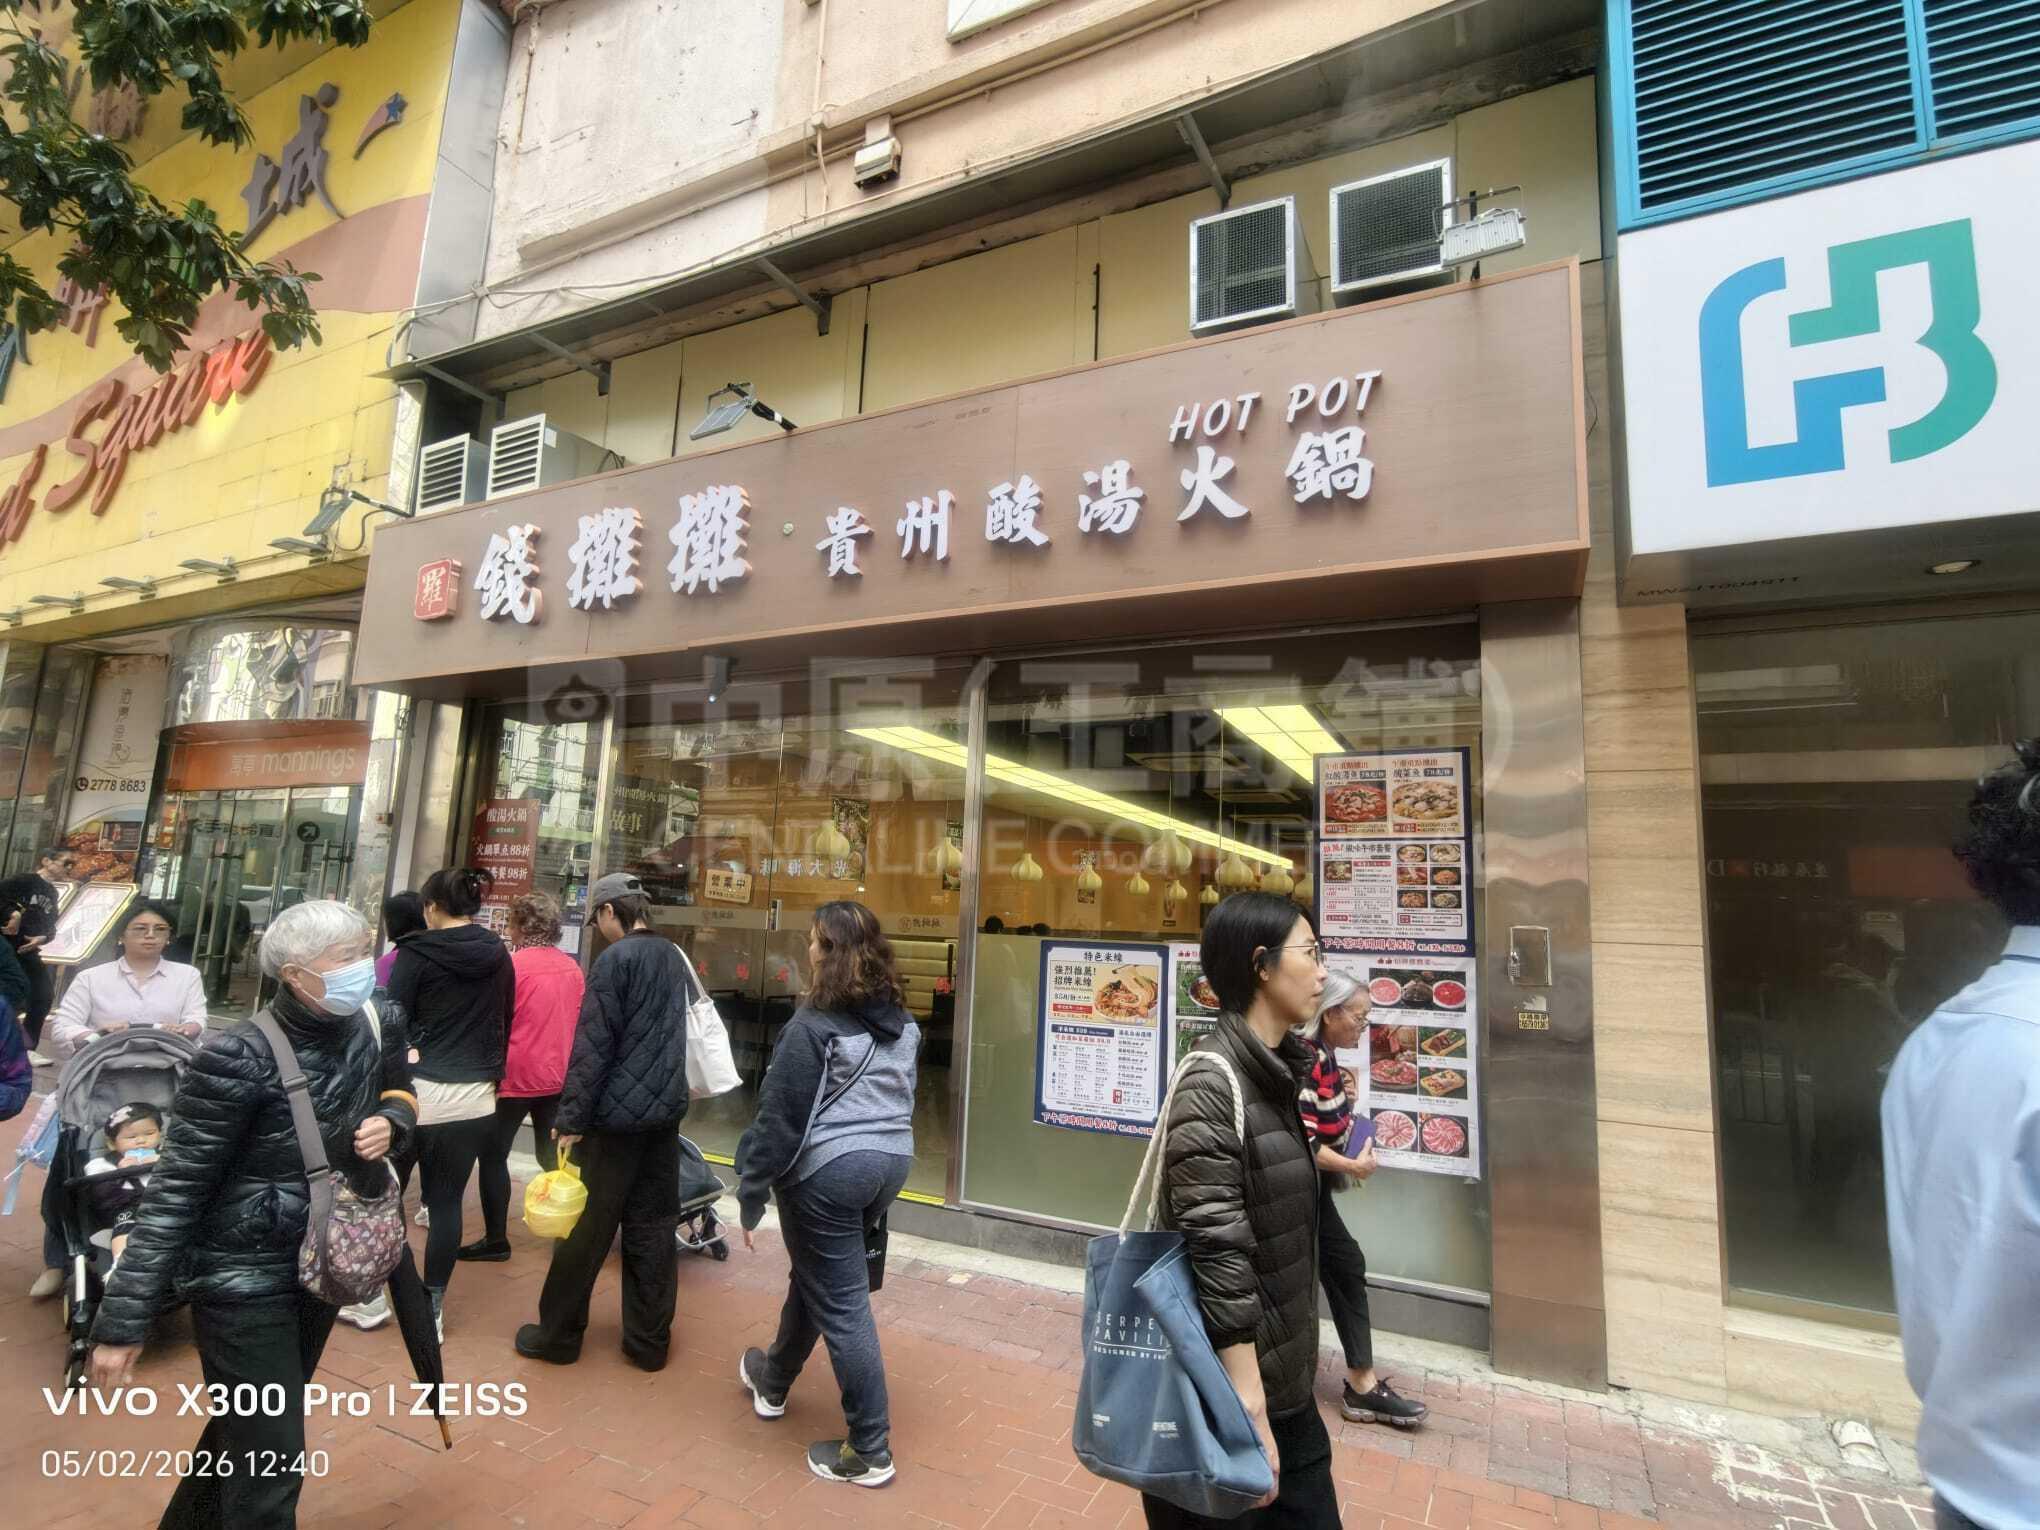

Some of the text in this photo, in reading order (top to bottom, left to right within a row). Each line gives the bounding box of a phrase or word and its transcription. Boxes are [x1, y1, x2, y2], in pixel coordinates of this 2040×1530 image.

[1168, 369, 1383, 443] HOT POT
[474, 425, 1377, 624] 錢攤攤 貴州酸湯火鍋
[90, 778, 146, 793] 2778 8683
[262, 746, 355, 777] mannings
